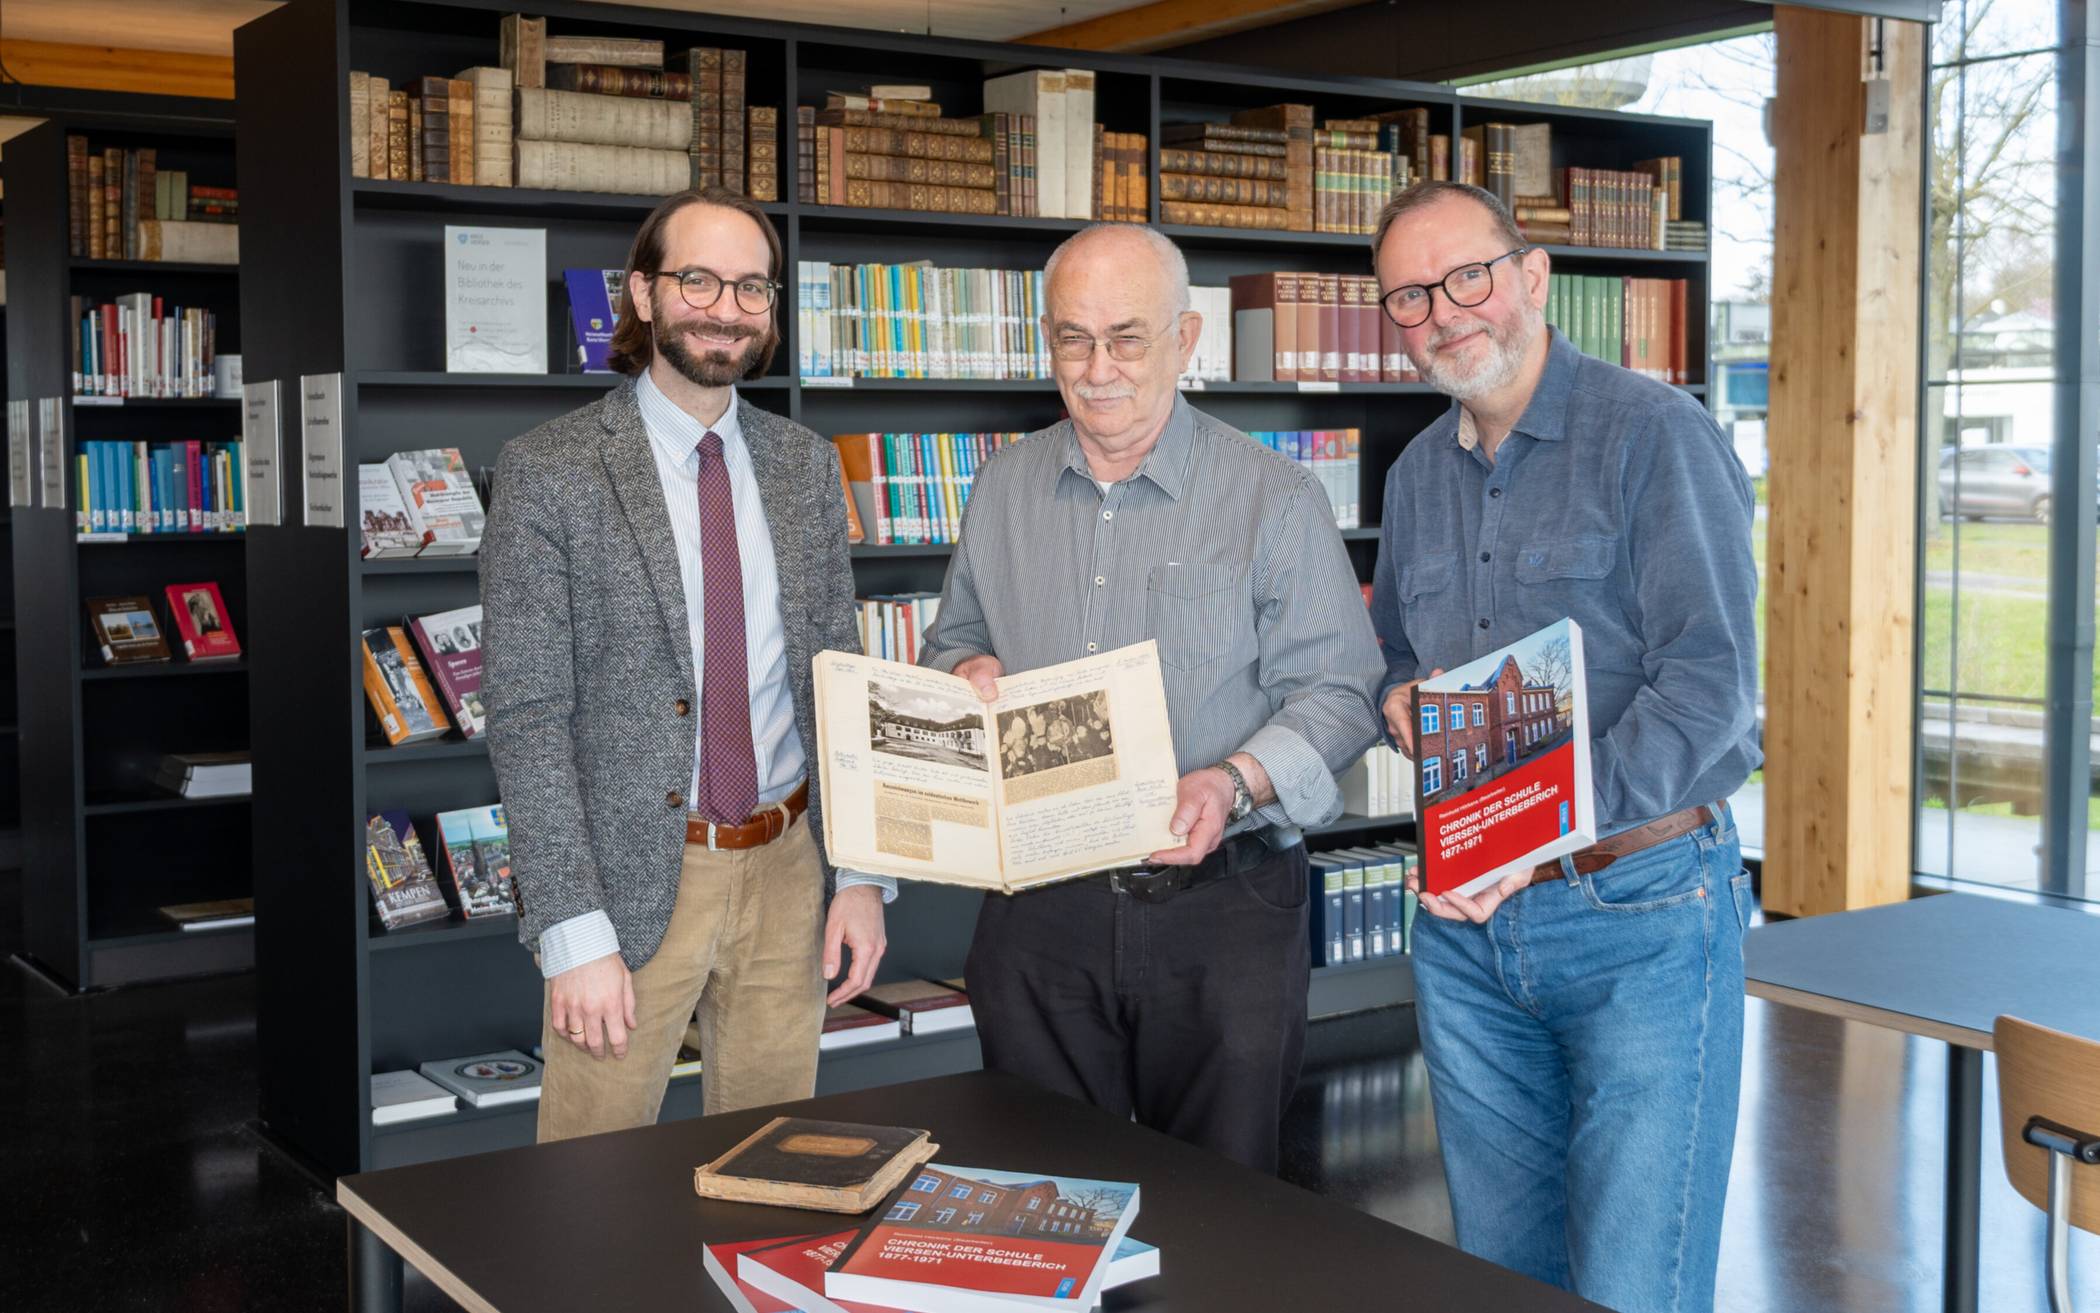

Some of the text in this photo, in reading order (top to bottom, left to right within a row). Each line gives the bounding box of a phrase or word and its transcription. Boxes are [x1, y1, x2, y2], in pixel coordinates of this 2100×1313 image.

[457, 260, 504, 272] Neu in der
[457, 277, 522, 290] Bibliothek des
[458, 295, 515, 306] Kreisarchivs
[1439, 809, 1482, 835] CHRONIK
[1483, 800, 1503, 816] DER
[1504, 781, 1541, 806] SCHULE
[1439, 784, 1559, 847] VIERSEN-UNTERBEBERICH
[1440, 834, 1483, 860] 1877-1971
[388, 885, 432, 904] KEMPEN
[879, 1252, 943, 1264] 1877-1971
[883, 1244, 1067, 1270] VIERSEN-UNTERBEBERICH
[887, 1238, 951, 1250] CHRONIK
[953, 1245, 983, 1254] DER
[987, 1249, 1043, 1260] SCHULE
